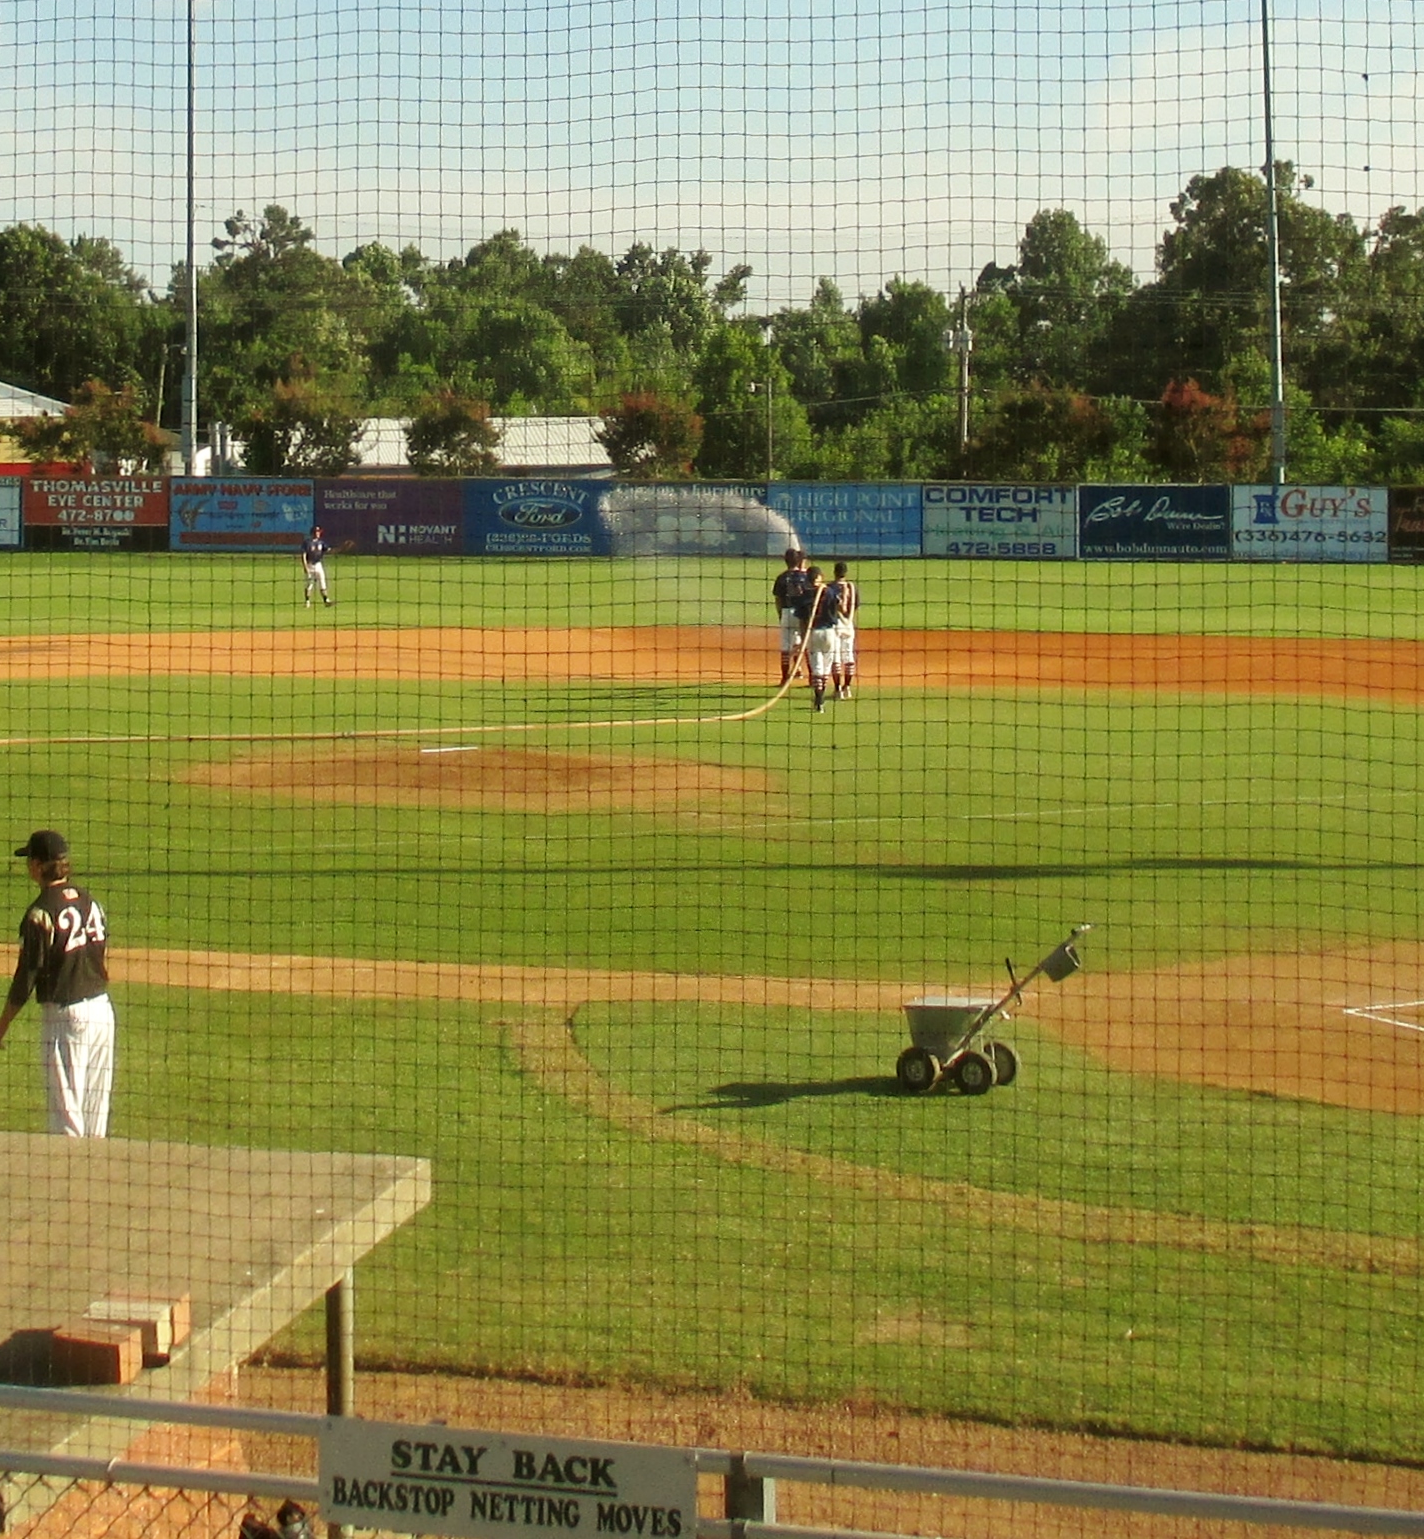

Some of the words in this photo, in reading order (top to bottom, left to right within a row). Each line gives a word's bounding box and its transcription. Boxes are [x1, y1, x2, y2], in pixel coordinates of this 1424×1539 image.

[30, 480, 162, 493] THOMASVILLE
[492, 481, 590, 505] CRESCENT
[692, 483, 765, 498] Furniture
[48, 495, 77, 506] EYE
[82, 495, 144, 507] CENTER
[324, 490, 375, 499] Healthcare
[378, 490, 396, 499] that
[798, 492, 849, 507] HIGH
[856, 492, 917, 507] POINT
[926, 487, 1072, 504] COMFORT
[324, 501, 352, 510] works
[354, 500, 367, 510] for
[370, 503, 387, 511] you
[514, 502, 565, 524] Ford
[1083, 496, 1143, 528] Bob
[1143, 496, 1225, 521] Dunn
[57, 509, 135, 522] 472-8700
[798, 508, 899, 523] REGIONAL
[959, 506, 1037, 522] TECH
[409, 525, 457, 535] NOVANT
[1234, 529, 1388, 544] (336)476-5632
[409, 535, 453, 544] HEALTH
[947, 542, 1056, 555] 472-5858
[1084, 542, 1228, 554] www.bobdunnauto.com
[57, 901, 106, 953] 24
[391, 1439, 488, 1476] STAY
[512, 1449, 617, 1488] BACK
[332, 1475, 454, 1517] BACKSTOP
[470, 1490, 581, 1529] NETTING
[596, 1501, 683, 1539] MOVES
